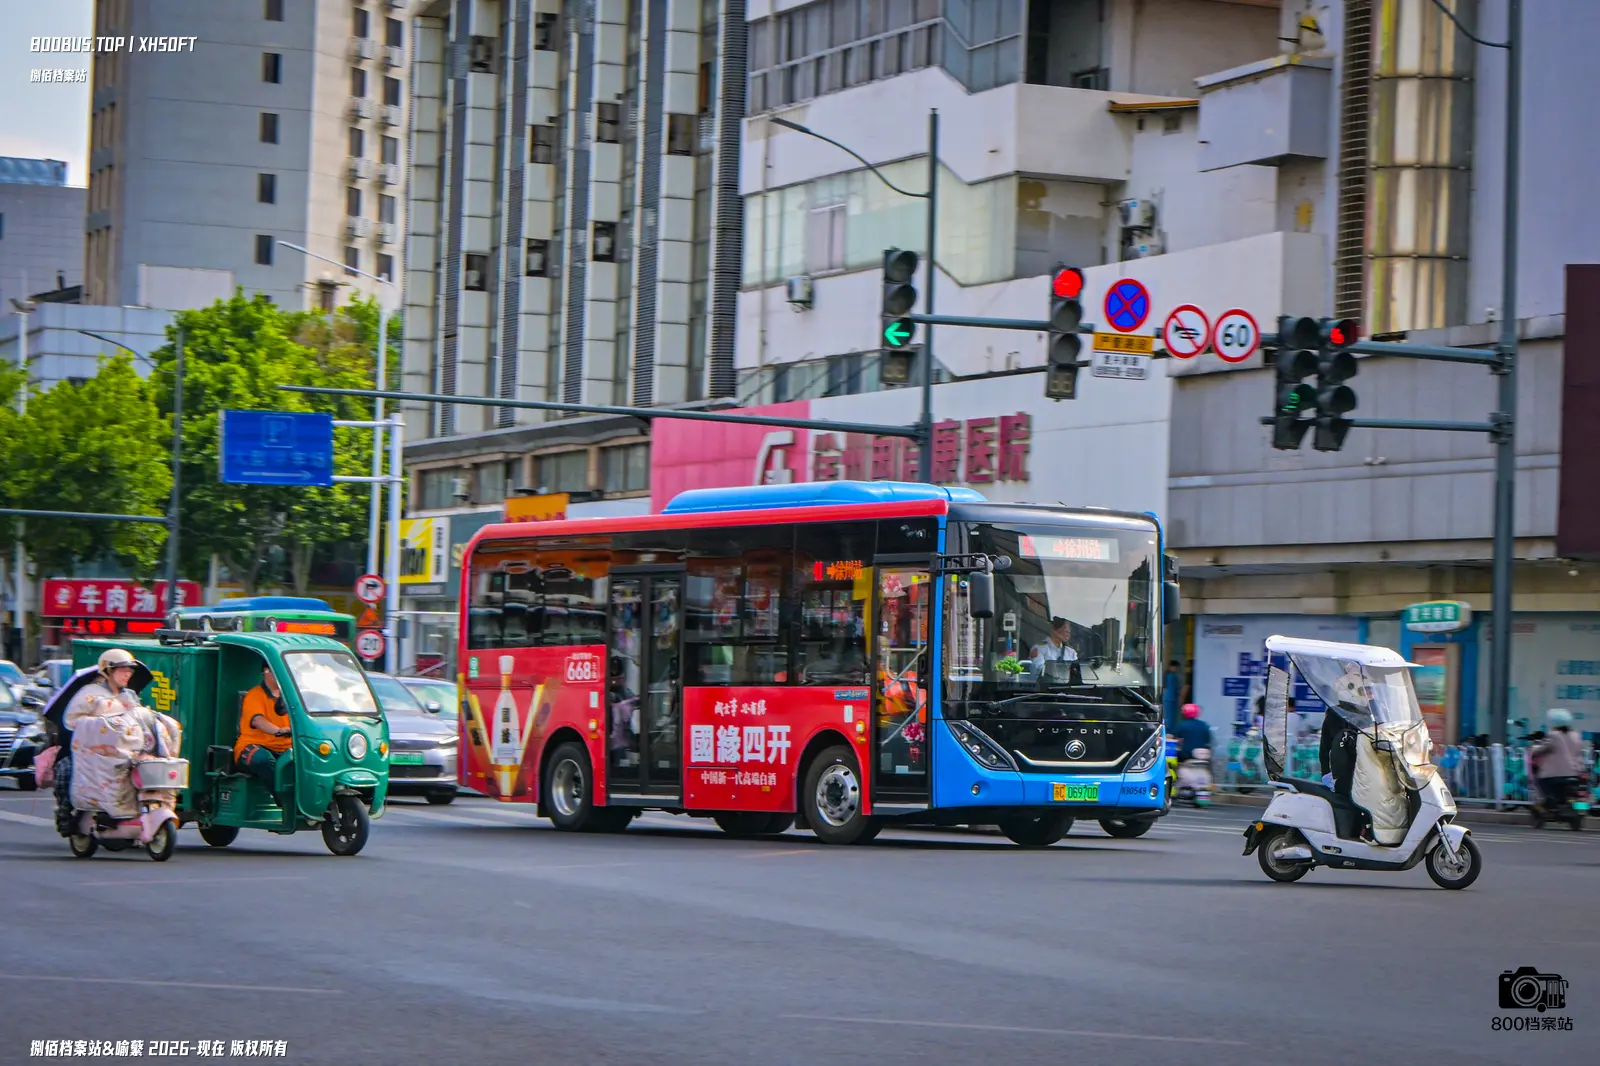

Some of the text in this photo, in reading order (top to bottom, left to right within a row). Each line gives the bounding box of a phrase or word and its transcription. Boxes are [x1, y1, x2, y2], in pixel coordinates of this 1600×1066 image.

[1222, 323, 1249, 348] 60
[568, 661, 591, 680] 668
[1037, 727, 1114, 735] YUTONG
[700, 770, 777, 786] 中国新一代高端白酒
